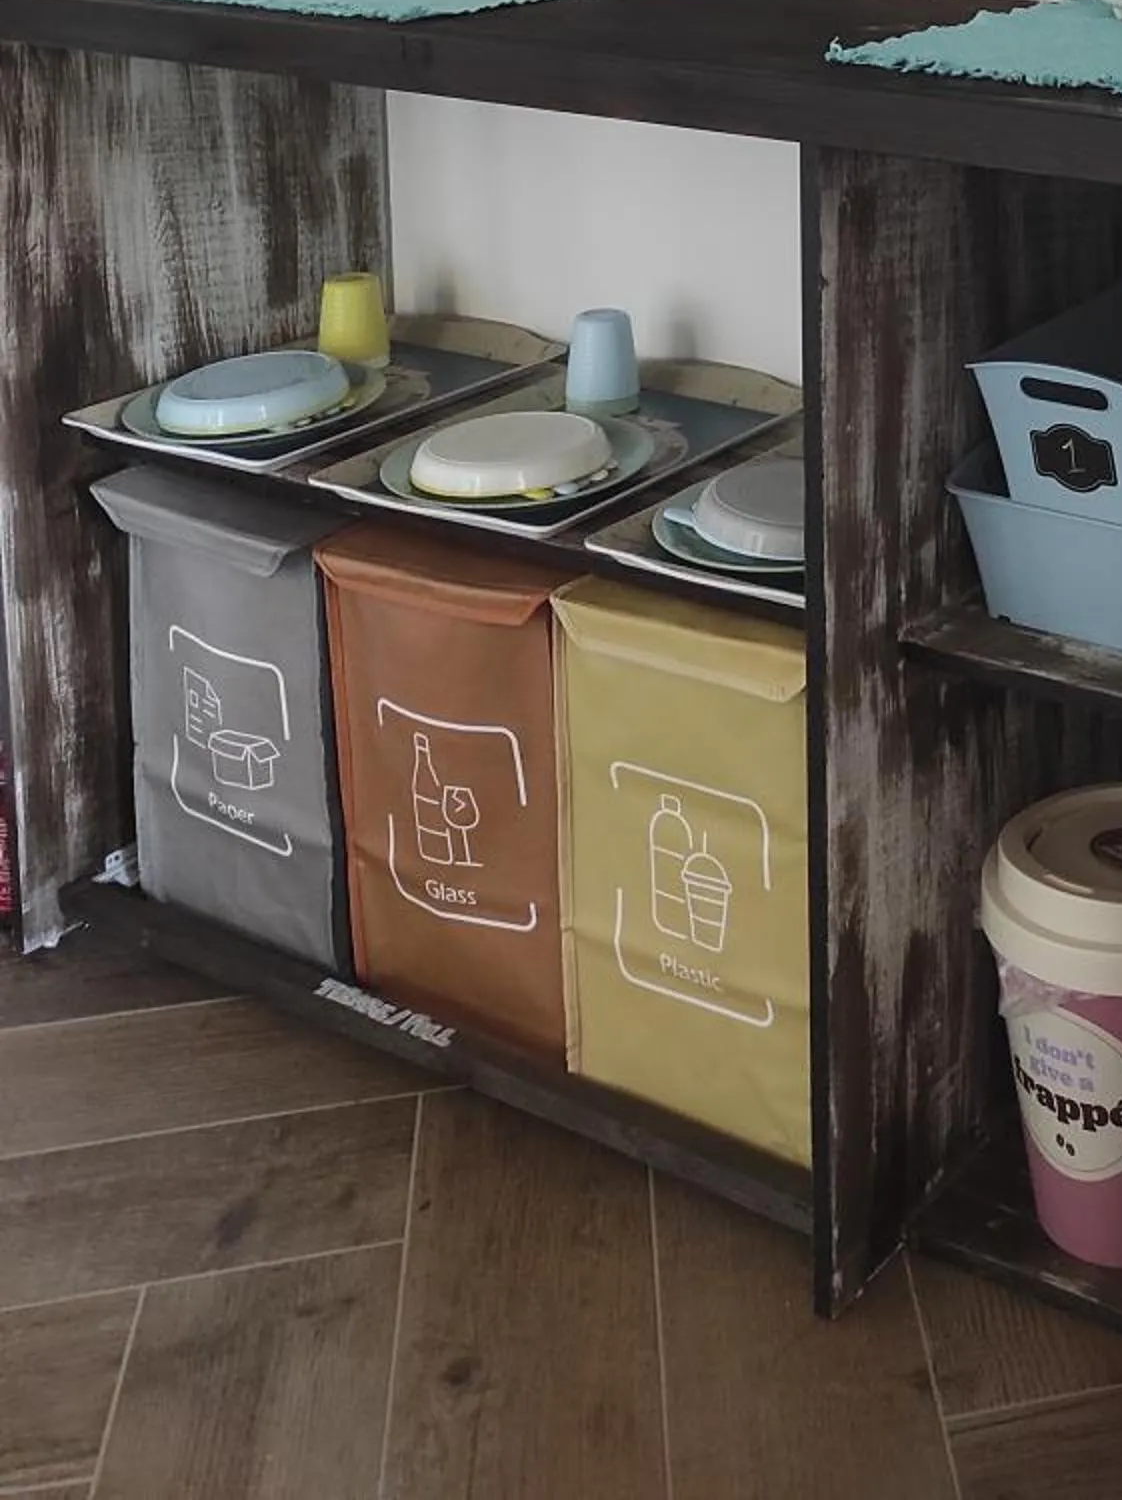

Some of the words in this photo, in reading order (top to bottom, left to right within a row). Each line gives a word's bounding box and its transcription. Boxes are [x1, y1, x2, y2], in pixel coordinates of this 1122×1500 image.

[1060, 437, 1087, 475] 1
[207, 790, 256, 826] Paper
[424, 877, 479, 907] Glass
[658, 950, 722, 993] Plastic
[1034, 1038, 1096, 1071] don't
[1029, 1056, 1073, 1088] give
